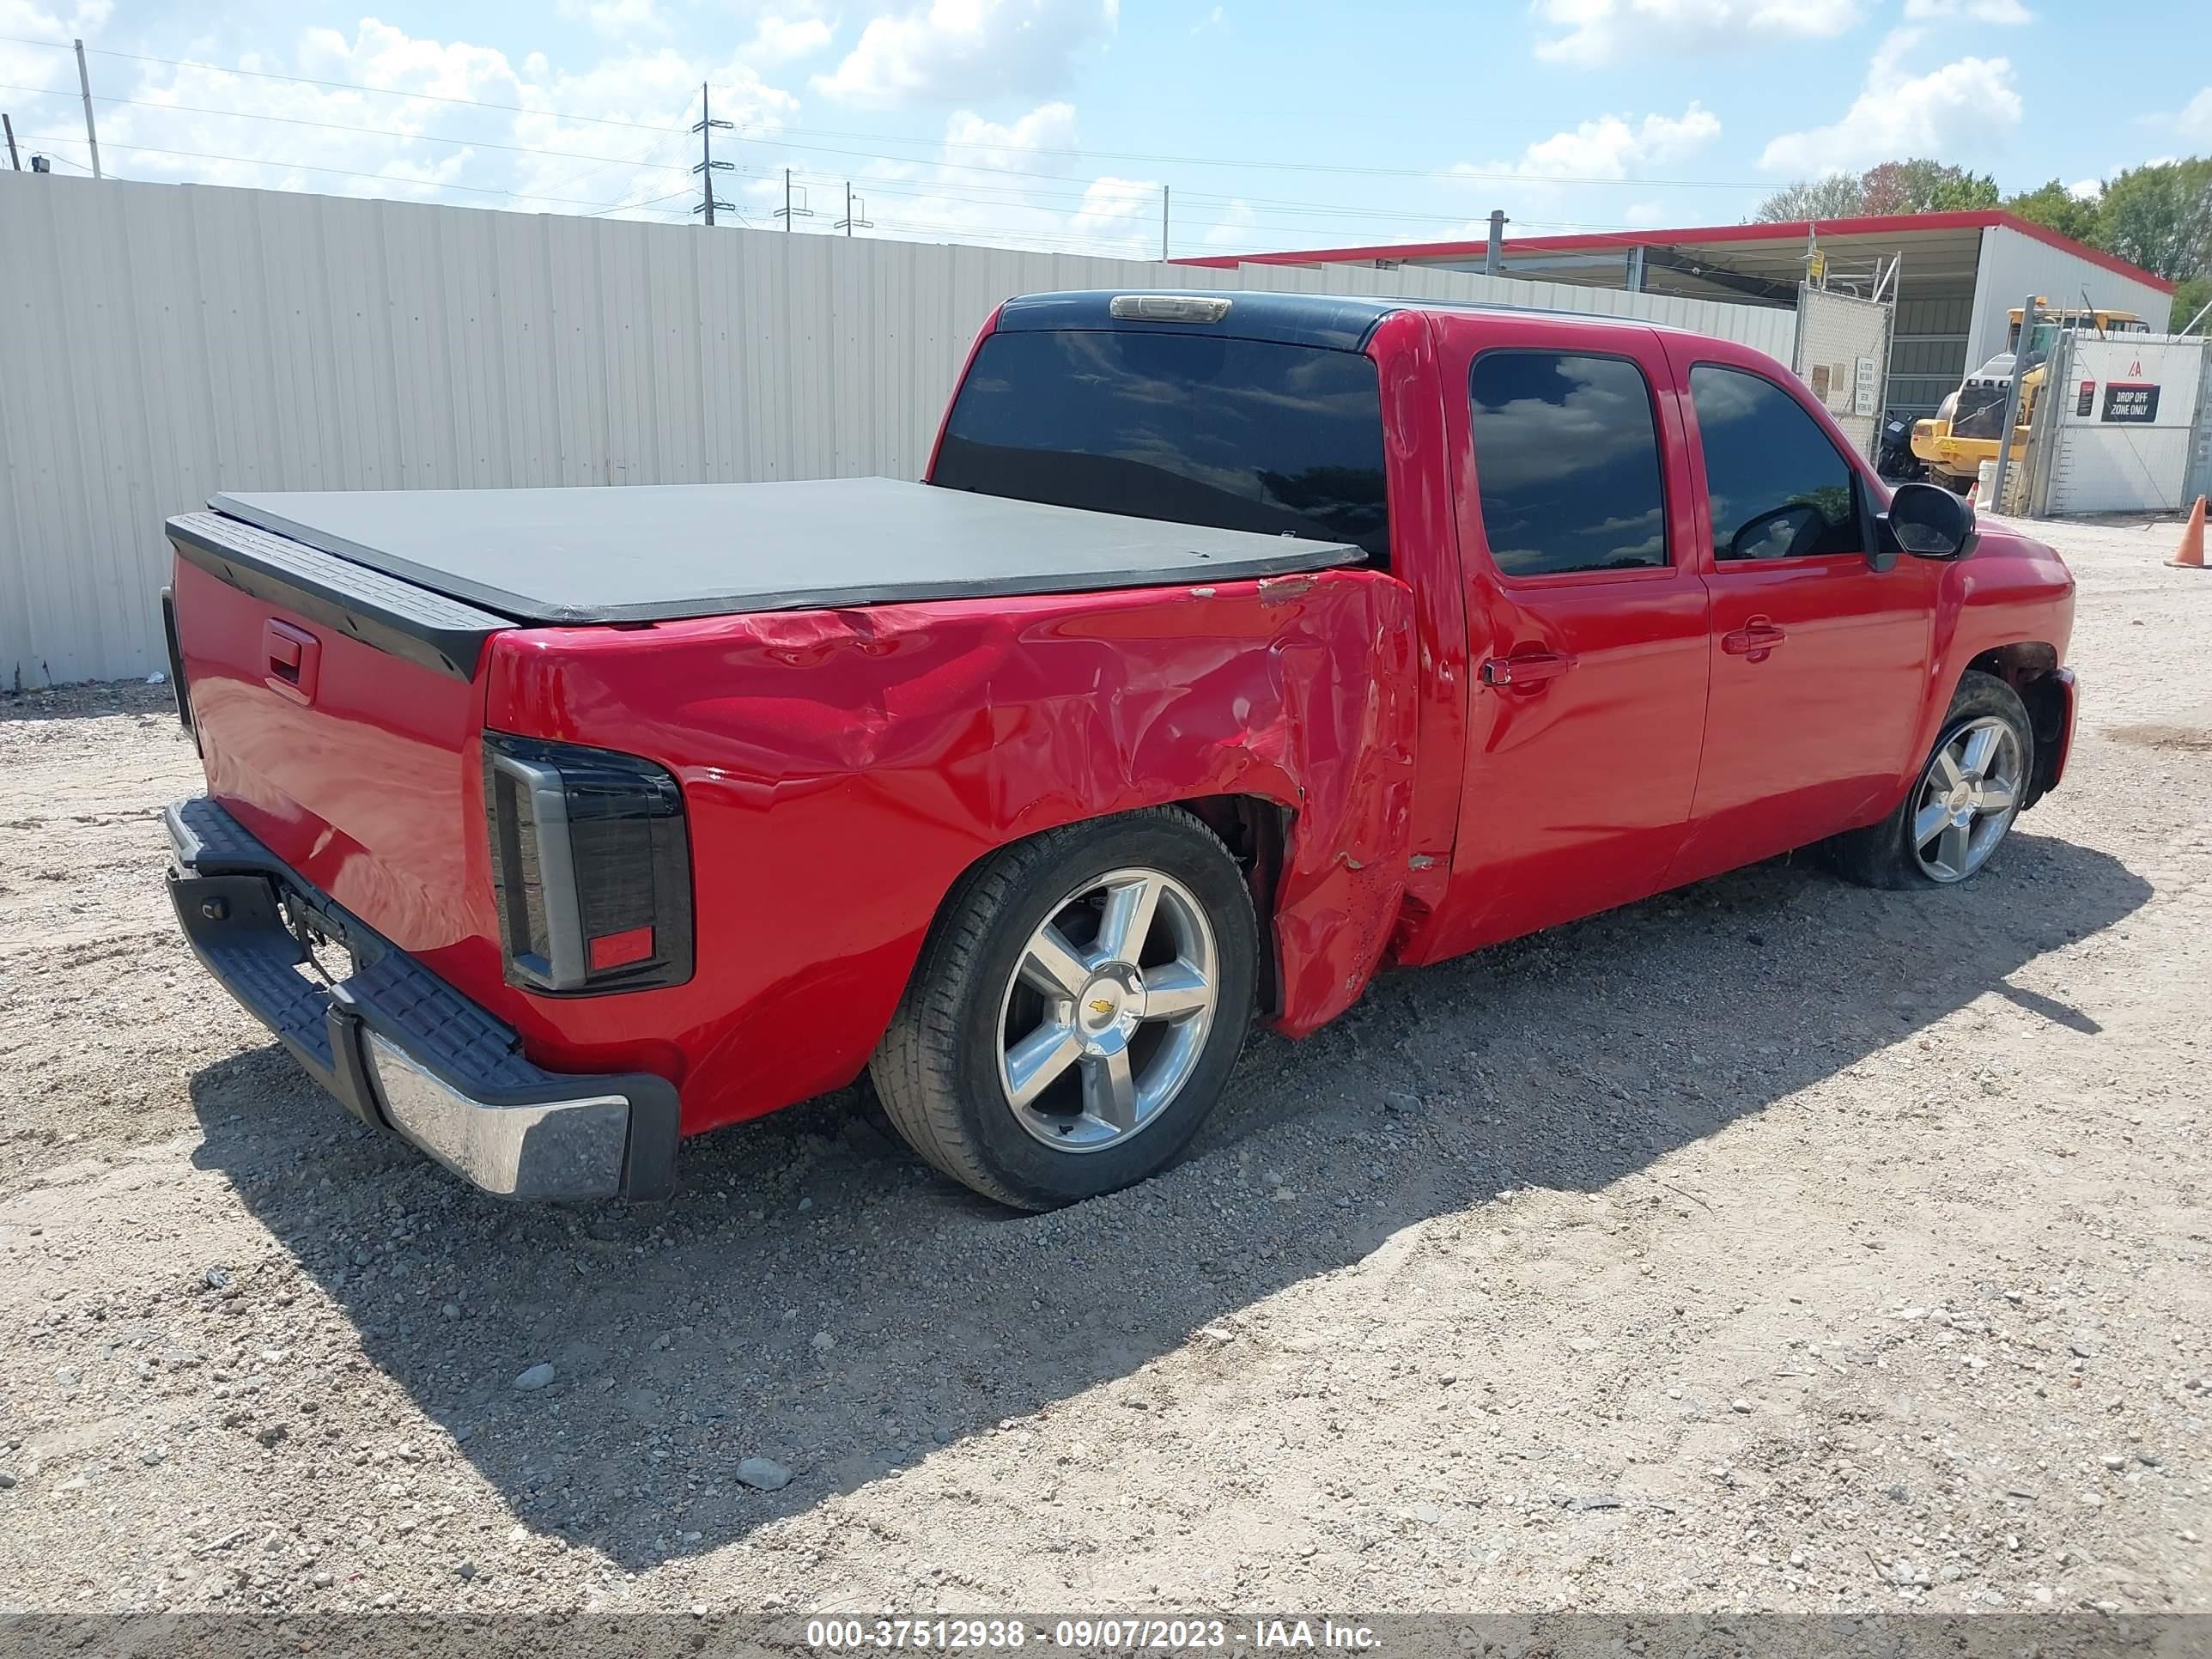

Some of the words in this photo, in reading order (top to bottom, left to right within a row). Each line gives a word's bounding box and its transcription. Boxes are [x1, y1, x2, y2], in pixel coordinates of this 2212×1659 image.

[2116, 392, 2134, 403] DROP
[2135, 392, 2148, 403] OFF
[2110, 404, 2130, 416] ZONE
[2130, 404, 2148, 416] ONLY
